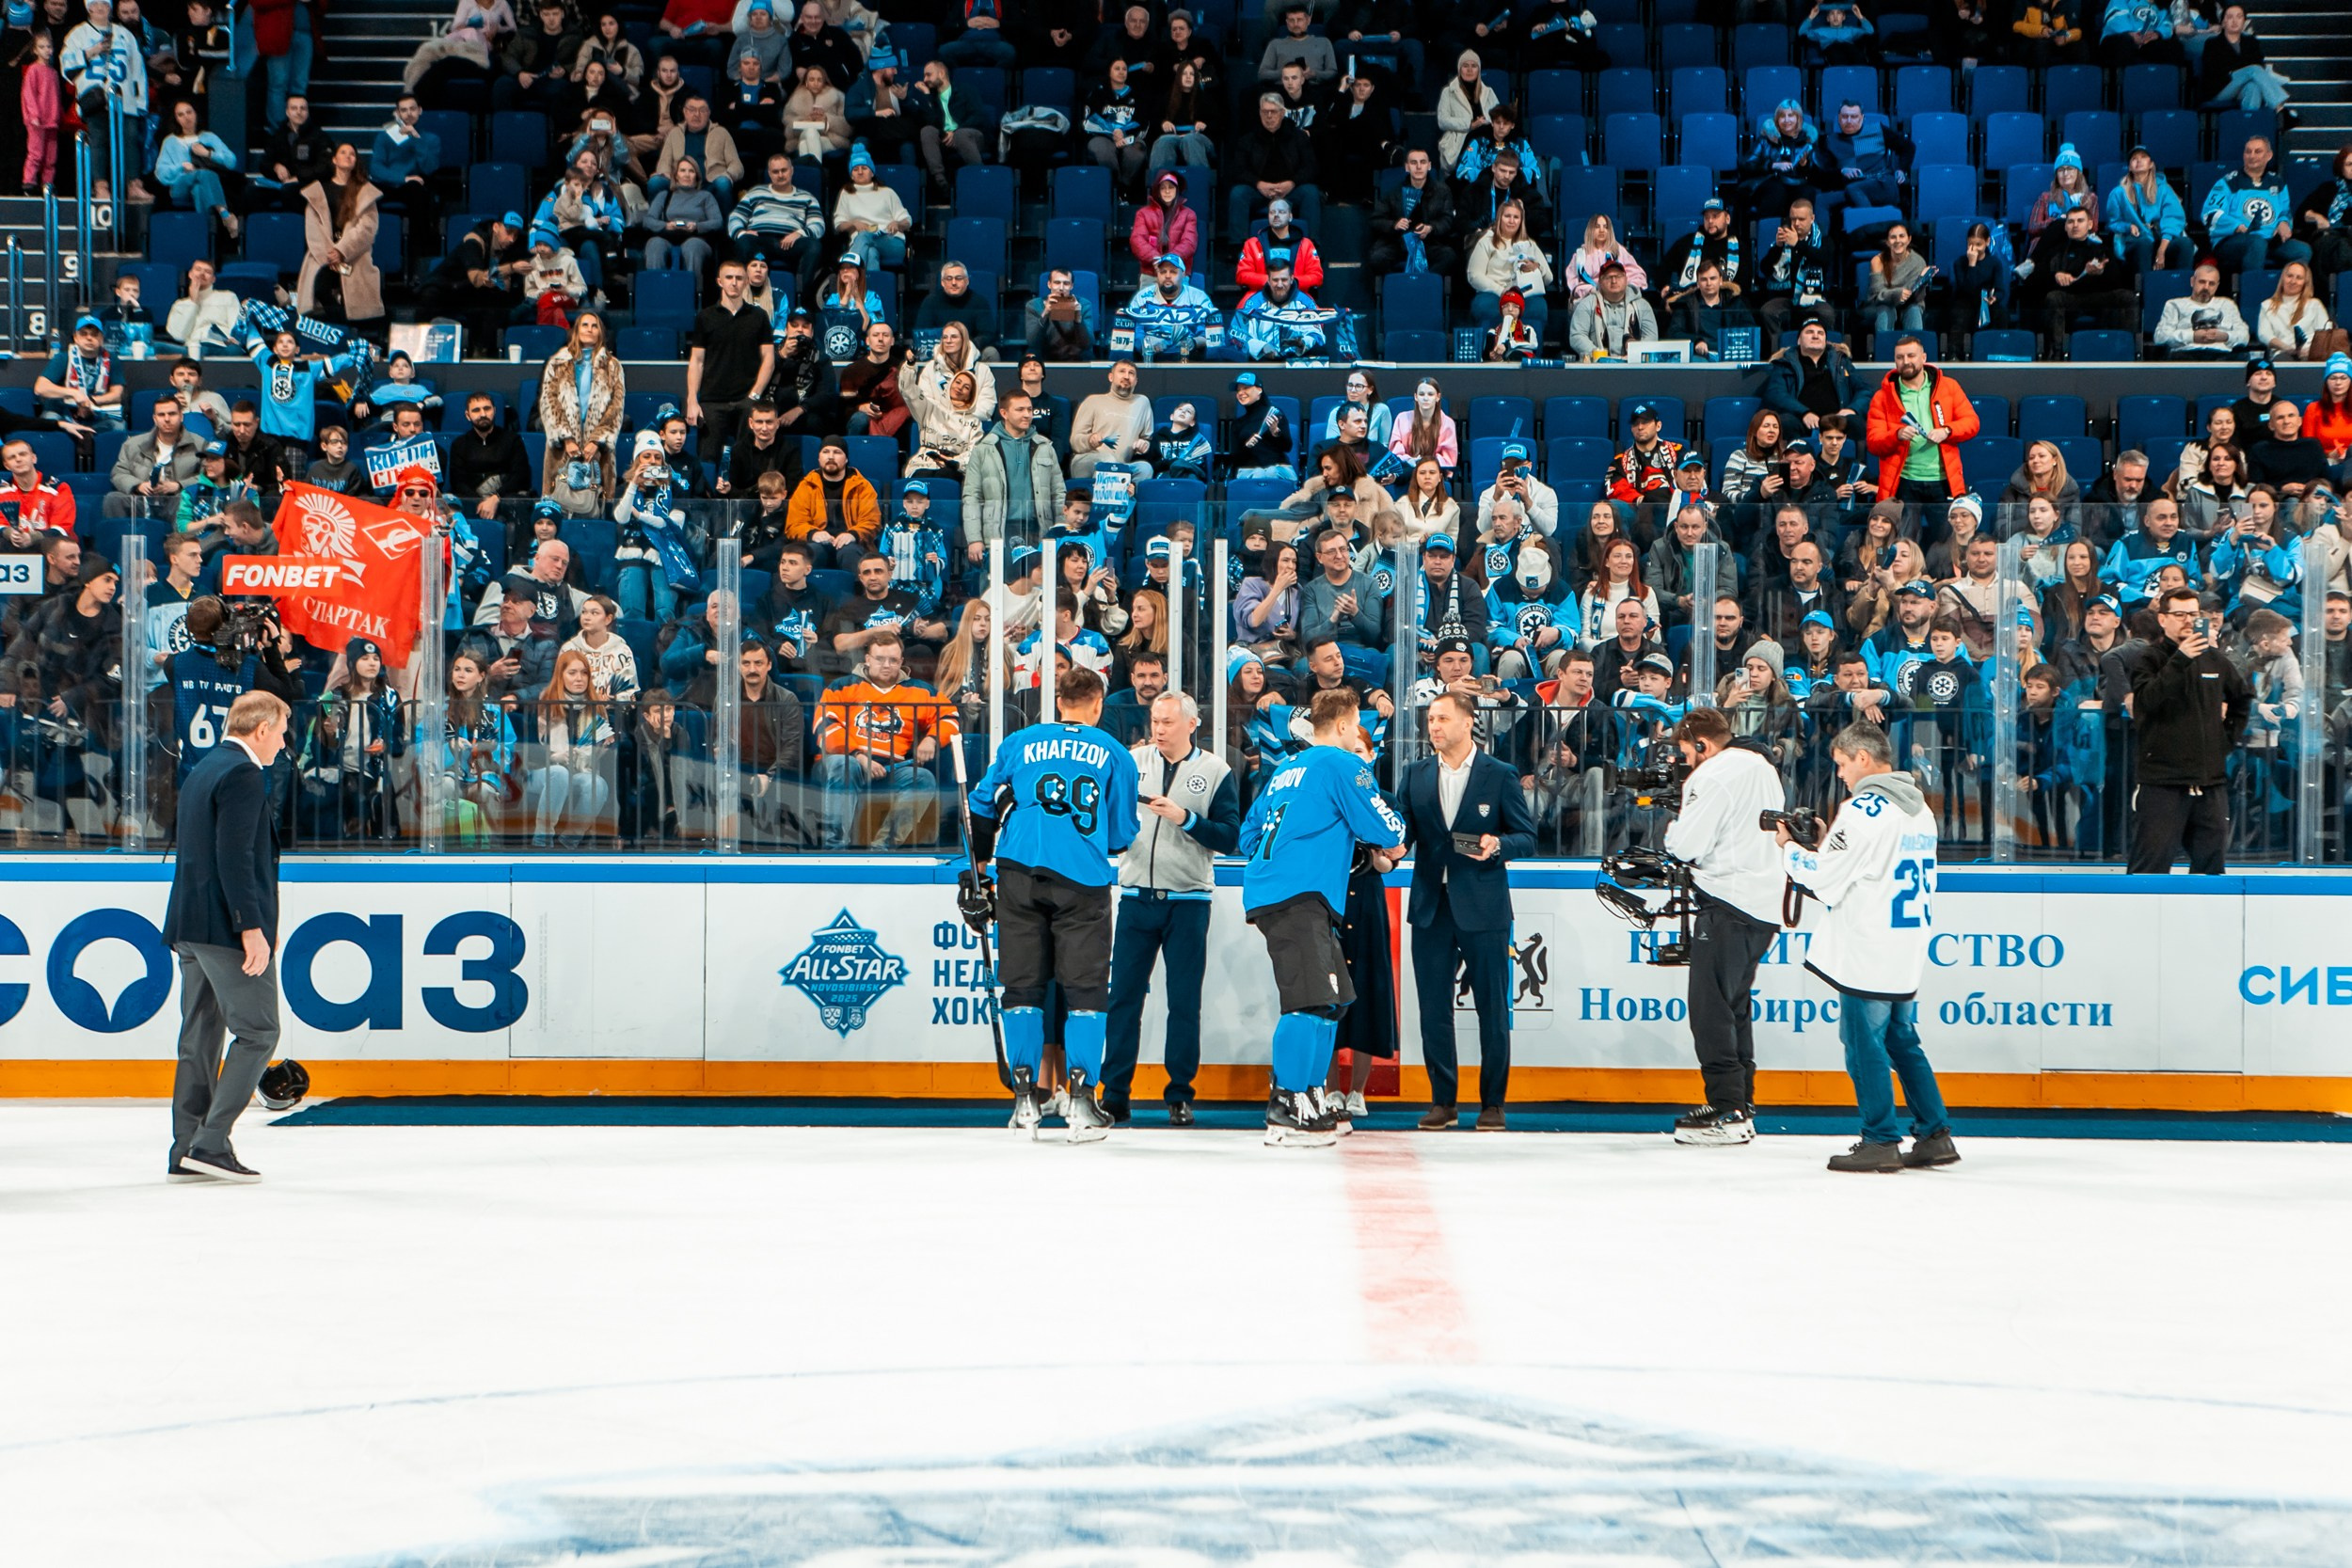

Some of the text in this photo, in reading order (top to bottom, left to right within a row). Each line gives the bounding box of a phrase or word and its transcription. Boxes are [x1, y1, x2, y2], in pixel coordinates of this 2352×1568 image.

[90, 204, 113, 228] 10
[63, 255, 79, 278] 9
[29, 311, 47, 336] 8
[226, 564, 342, 588] FONBET
[303, 595, 391, 640] СПАРТАК
[189, 704, 230, 748] 67
[1024, 738, 1110, 769] KHAFIZOV
[1035, 771, 1103, 837] 89
[1851, 792, 1890, 817] 25
[821, 944, 866, 954] FONBET
[810, 983, 881, 992] NOVOSIBIRSK
[830, 994, 859, 1003] 2025
[1939, 991, 2114, 1027] области
